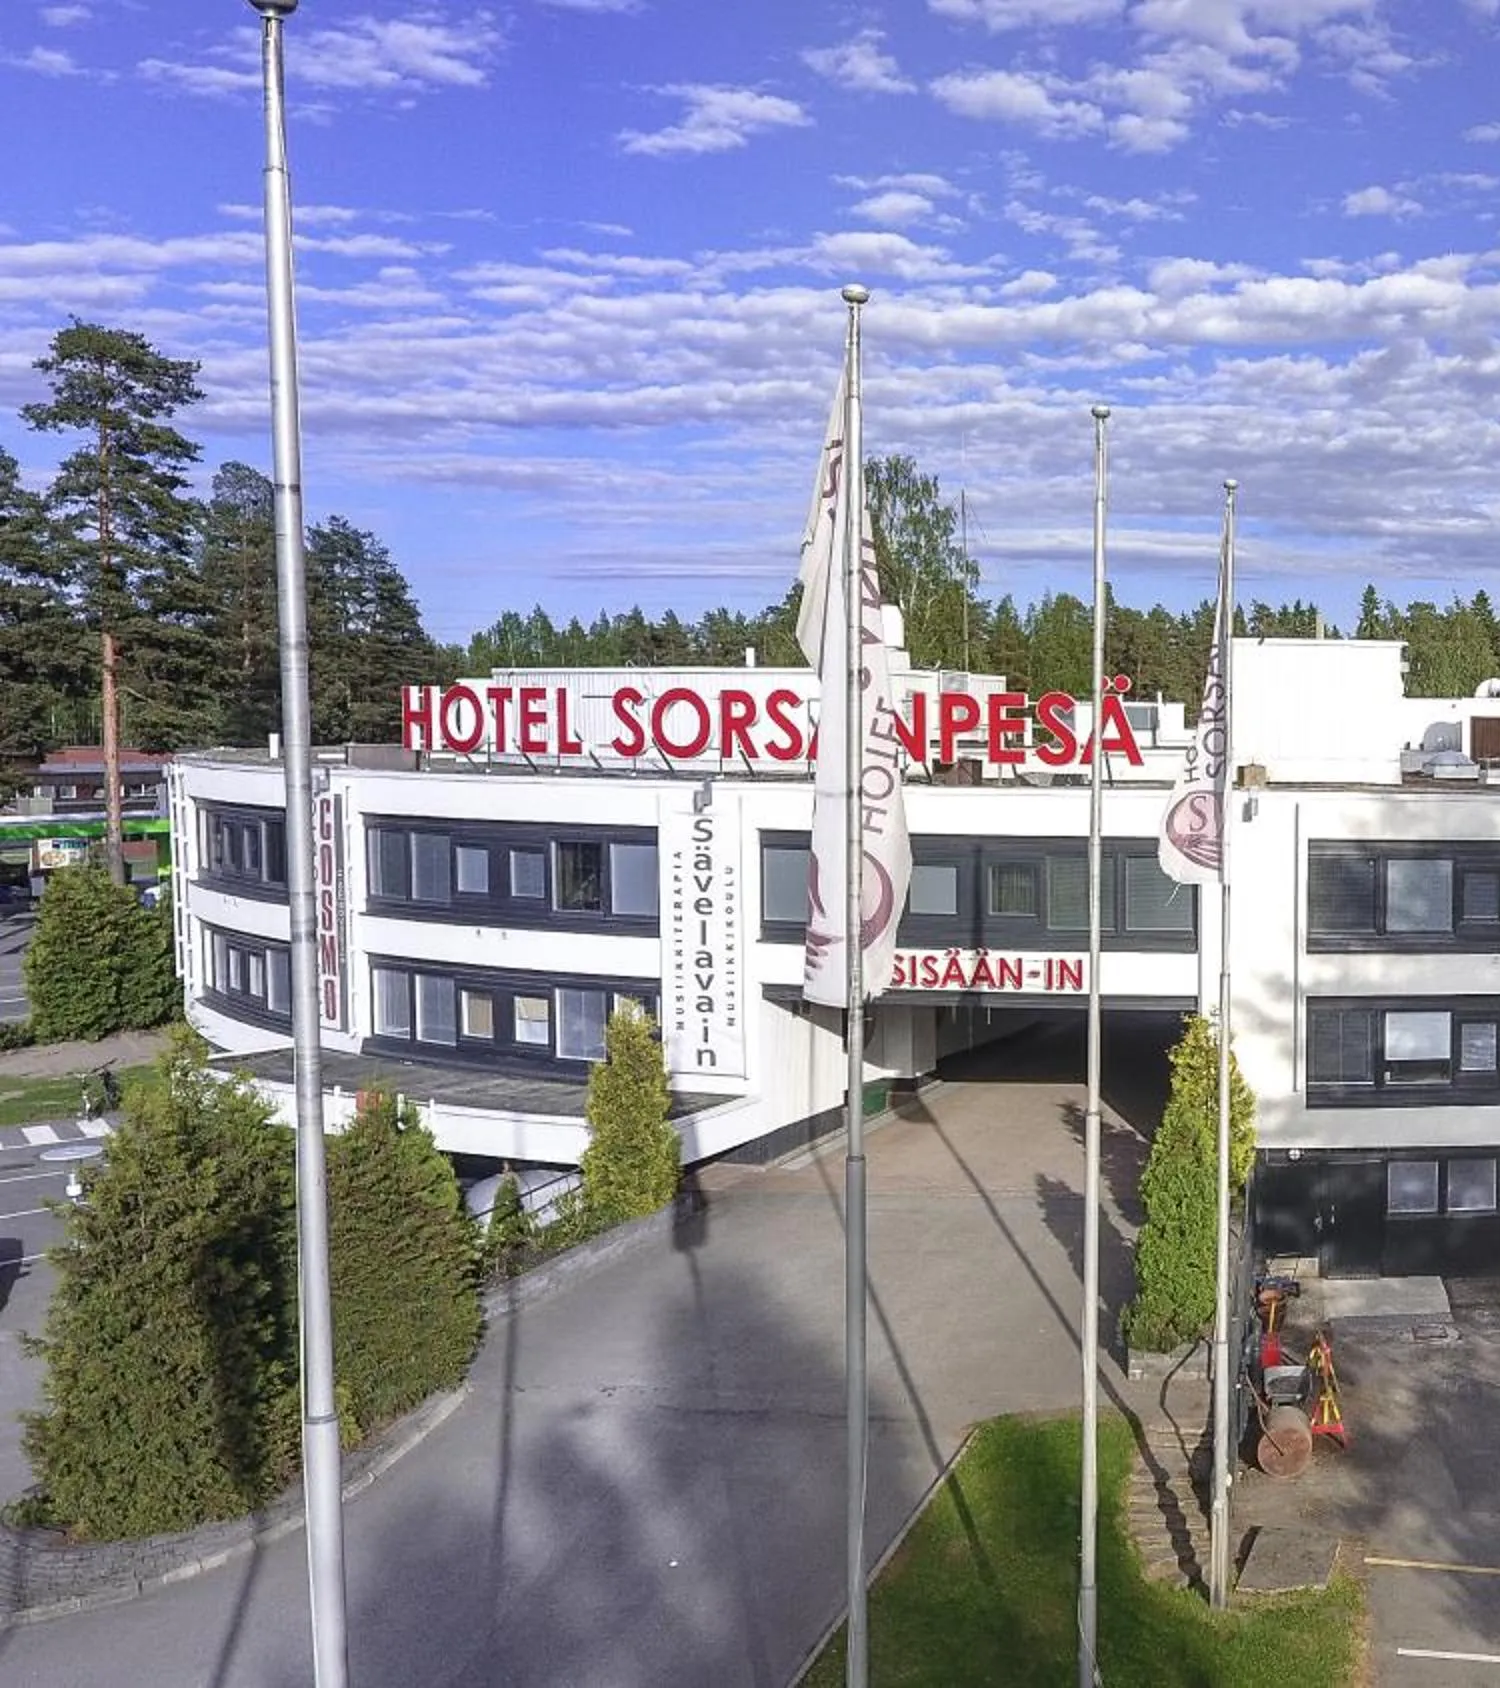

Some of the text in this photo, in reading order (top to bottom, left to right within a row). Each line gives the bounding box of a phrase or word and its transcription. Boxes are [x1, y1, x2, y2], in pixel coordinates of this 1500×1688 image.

[402, 673, 1145, 767] HOTEL SORSNPESÄ
[319, 798, 338, 1021] COSMO
[673, 851, 684, 1030] MUSIIKKITERAPIA
[691, 818, 717, 1067] Sävelavain
[724, 866, 736, 1027] MUSIIKKIKOULU
